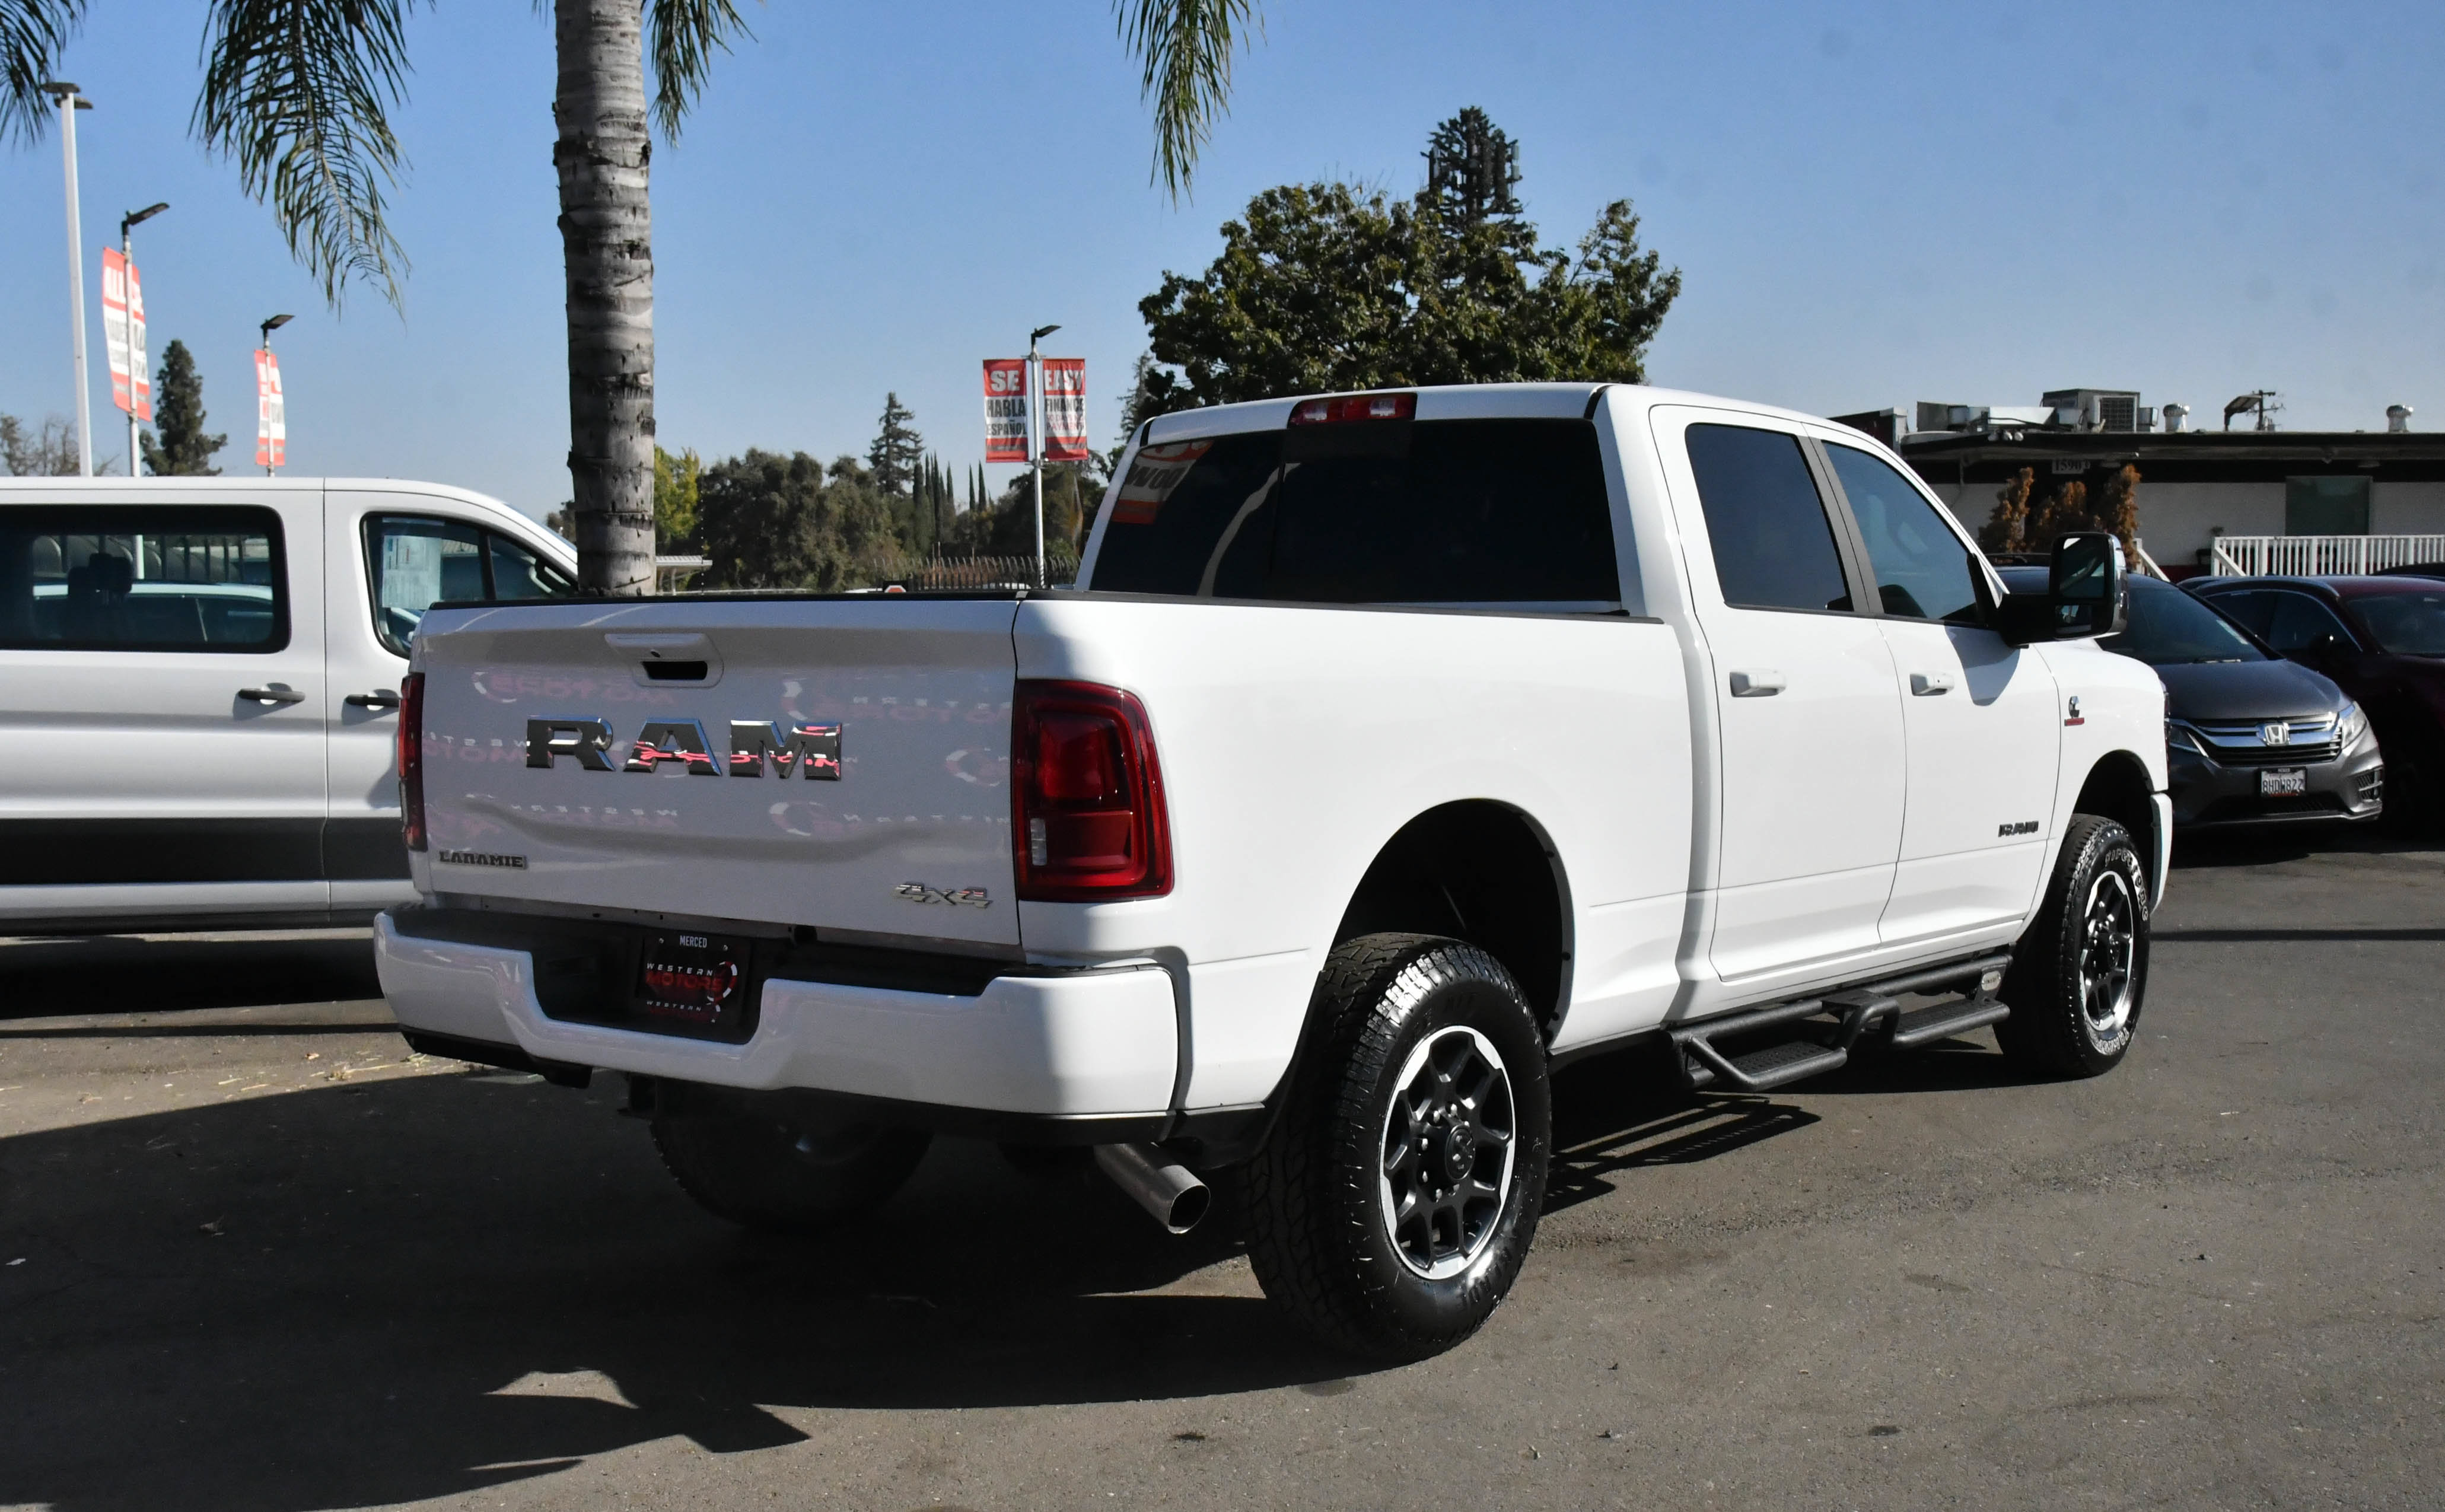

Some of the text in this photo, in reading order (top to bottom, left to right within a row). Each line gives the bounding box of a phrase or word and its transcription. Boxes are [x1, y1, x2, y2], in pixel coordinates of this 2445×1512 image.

[991, 370, 1020, 391] SE
[1045, 370, 1084, 391] EASY
[986, 399, 1026, 418] HABLA
[1045, 399, 1084, 412] FINANCE
[986, 419, 1027, 435] ESPAÑOL
[526, 715, 842, 781] RAM
[1998, 821, 2039, 837] RAM
[439, 851, 526, 870] LARAMIE
[680, 935, 708, 948] MERCED
[647, 963, 714, 976] WESTERN
[645, 971, 723, 992] MOTORS
